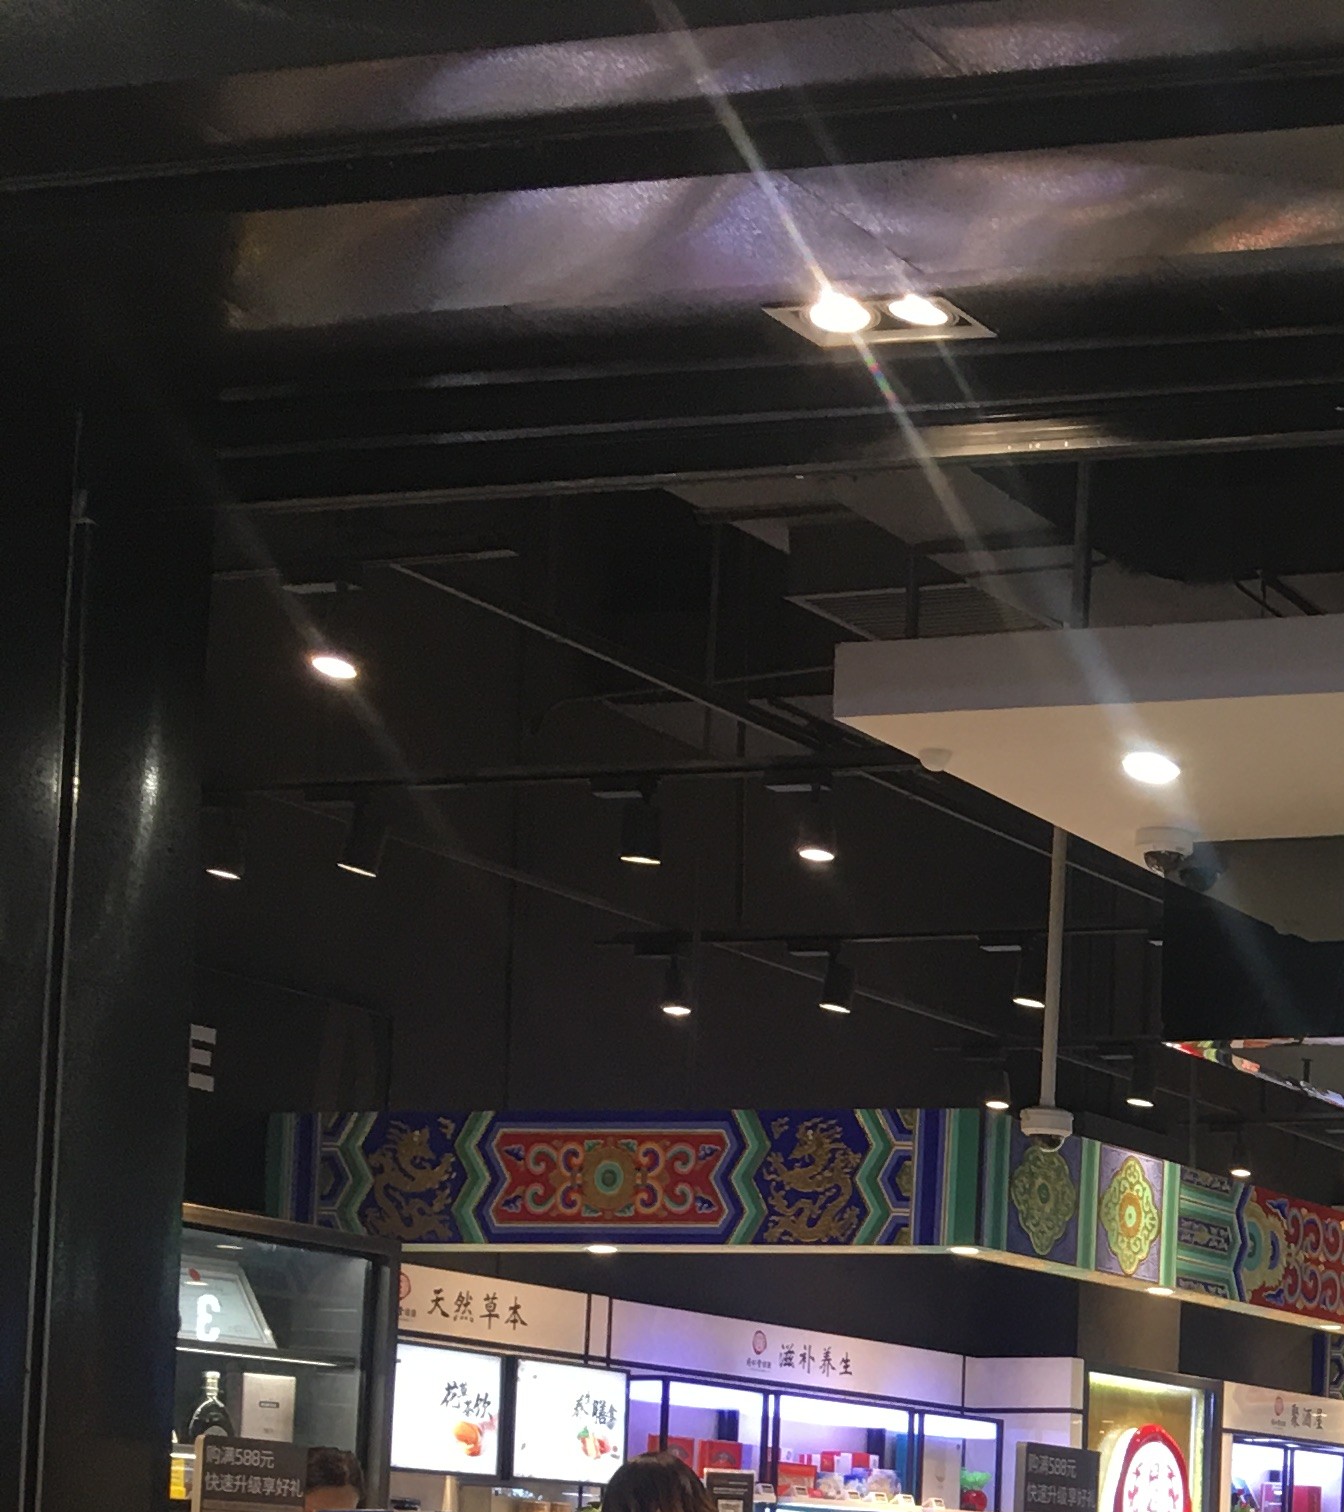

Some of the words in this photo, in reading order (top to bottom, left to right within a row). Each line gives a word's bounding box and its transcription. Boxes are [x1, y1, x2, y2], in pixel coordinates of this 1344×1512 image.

[427, 1287, 528, 1332] 天然草本
[779, 1343, 853, 1378] 滋补养生
[205, 1445, 275, 1470] 购满588元
[204, 1472, 304, 1498] 快速升级享好礼
